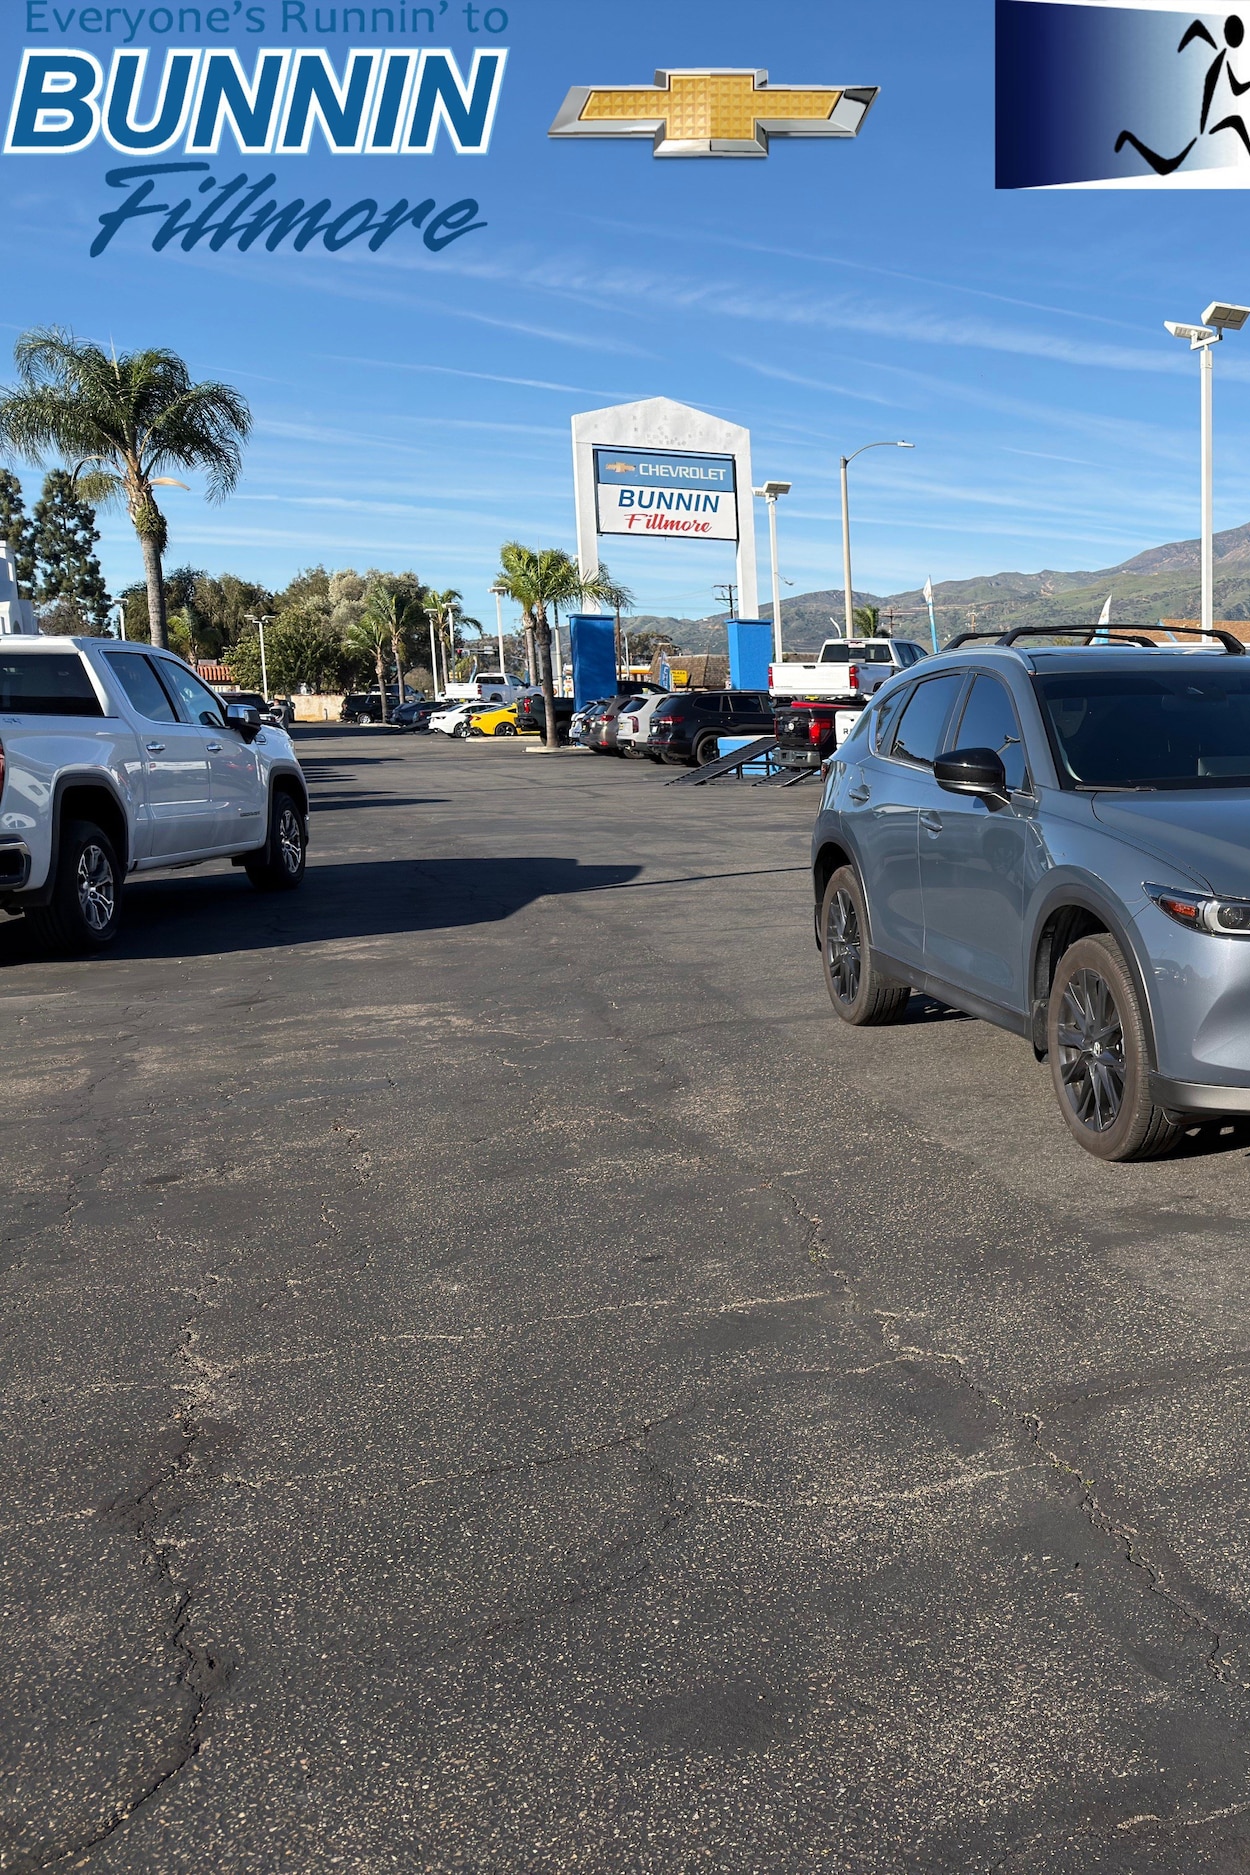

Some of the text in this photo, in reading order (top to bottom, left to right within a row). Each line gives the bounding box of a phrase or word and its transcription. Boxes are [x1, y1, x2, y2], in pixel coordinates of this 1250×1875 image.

[639, 463, 726, 481] CHEVROLET
[618, 489, 720, 513] BUNNIN
[624, 513, 712, 533] Fillmore
